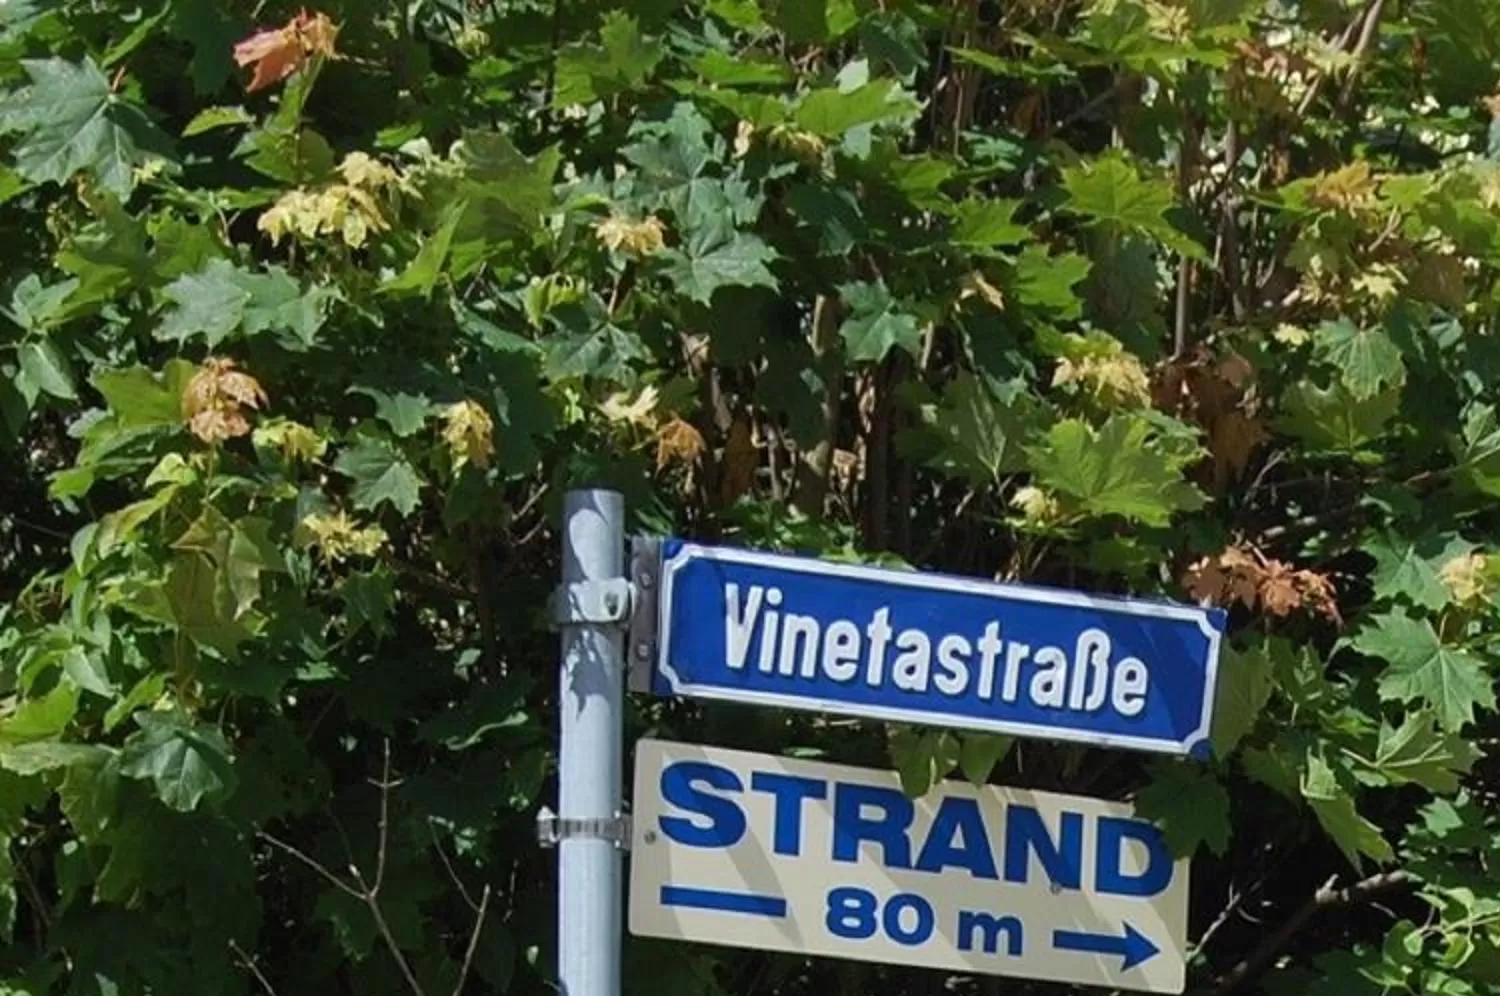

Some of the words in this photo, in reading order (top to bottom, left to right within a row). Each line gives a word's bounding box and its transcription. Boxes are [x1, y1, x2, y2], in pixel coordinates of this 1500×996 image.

[724, 582, 1148, 716] Vinetastraße
[658, 760, 1174, 897] STRAND
[826, 886, 935, 945] 80
[957, 909, 1025, 956] m
